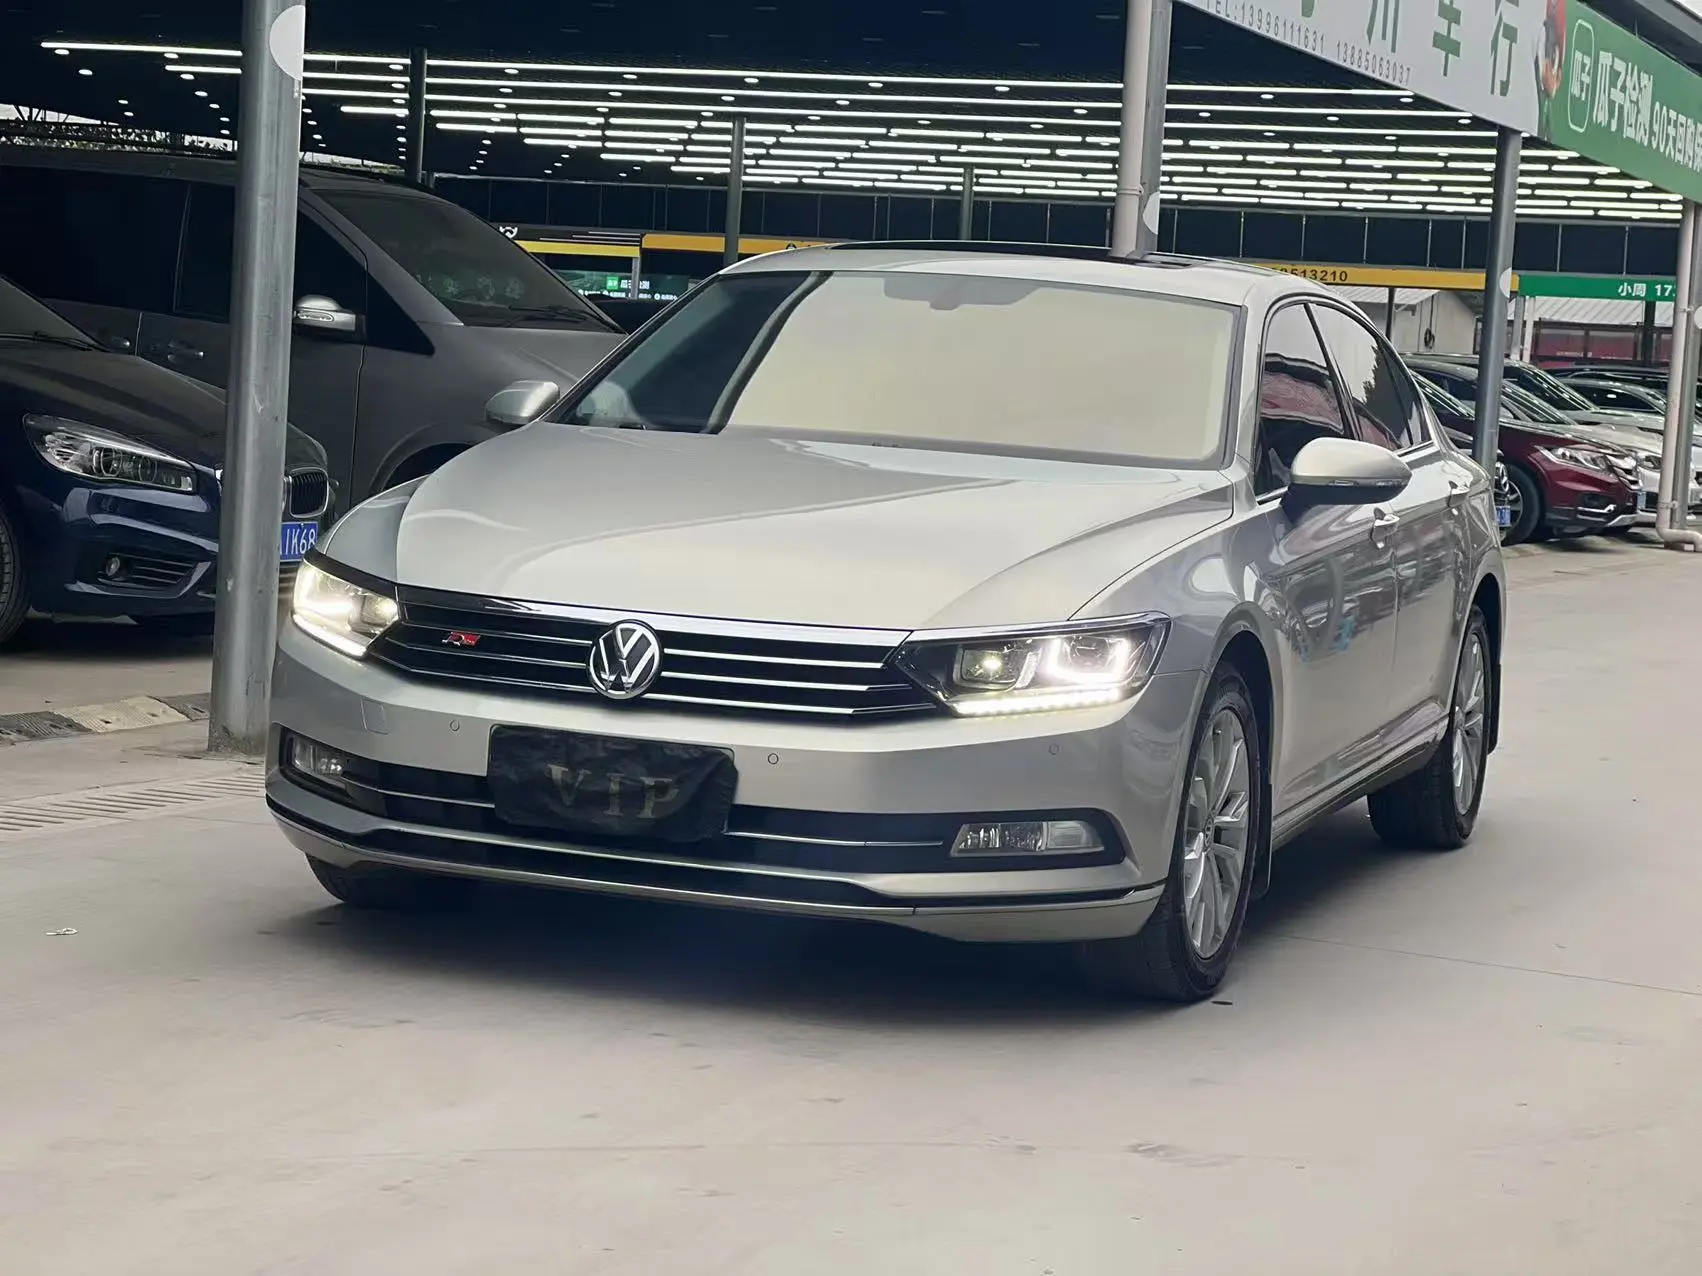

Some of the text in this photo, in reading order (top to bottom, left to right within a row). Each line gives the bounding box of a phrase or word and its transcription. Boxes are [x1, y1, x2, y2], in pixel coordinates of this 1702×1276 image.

[1593, 51, 1654, 147] 瓜子检测
[547, 763, 680, 819] VIP
